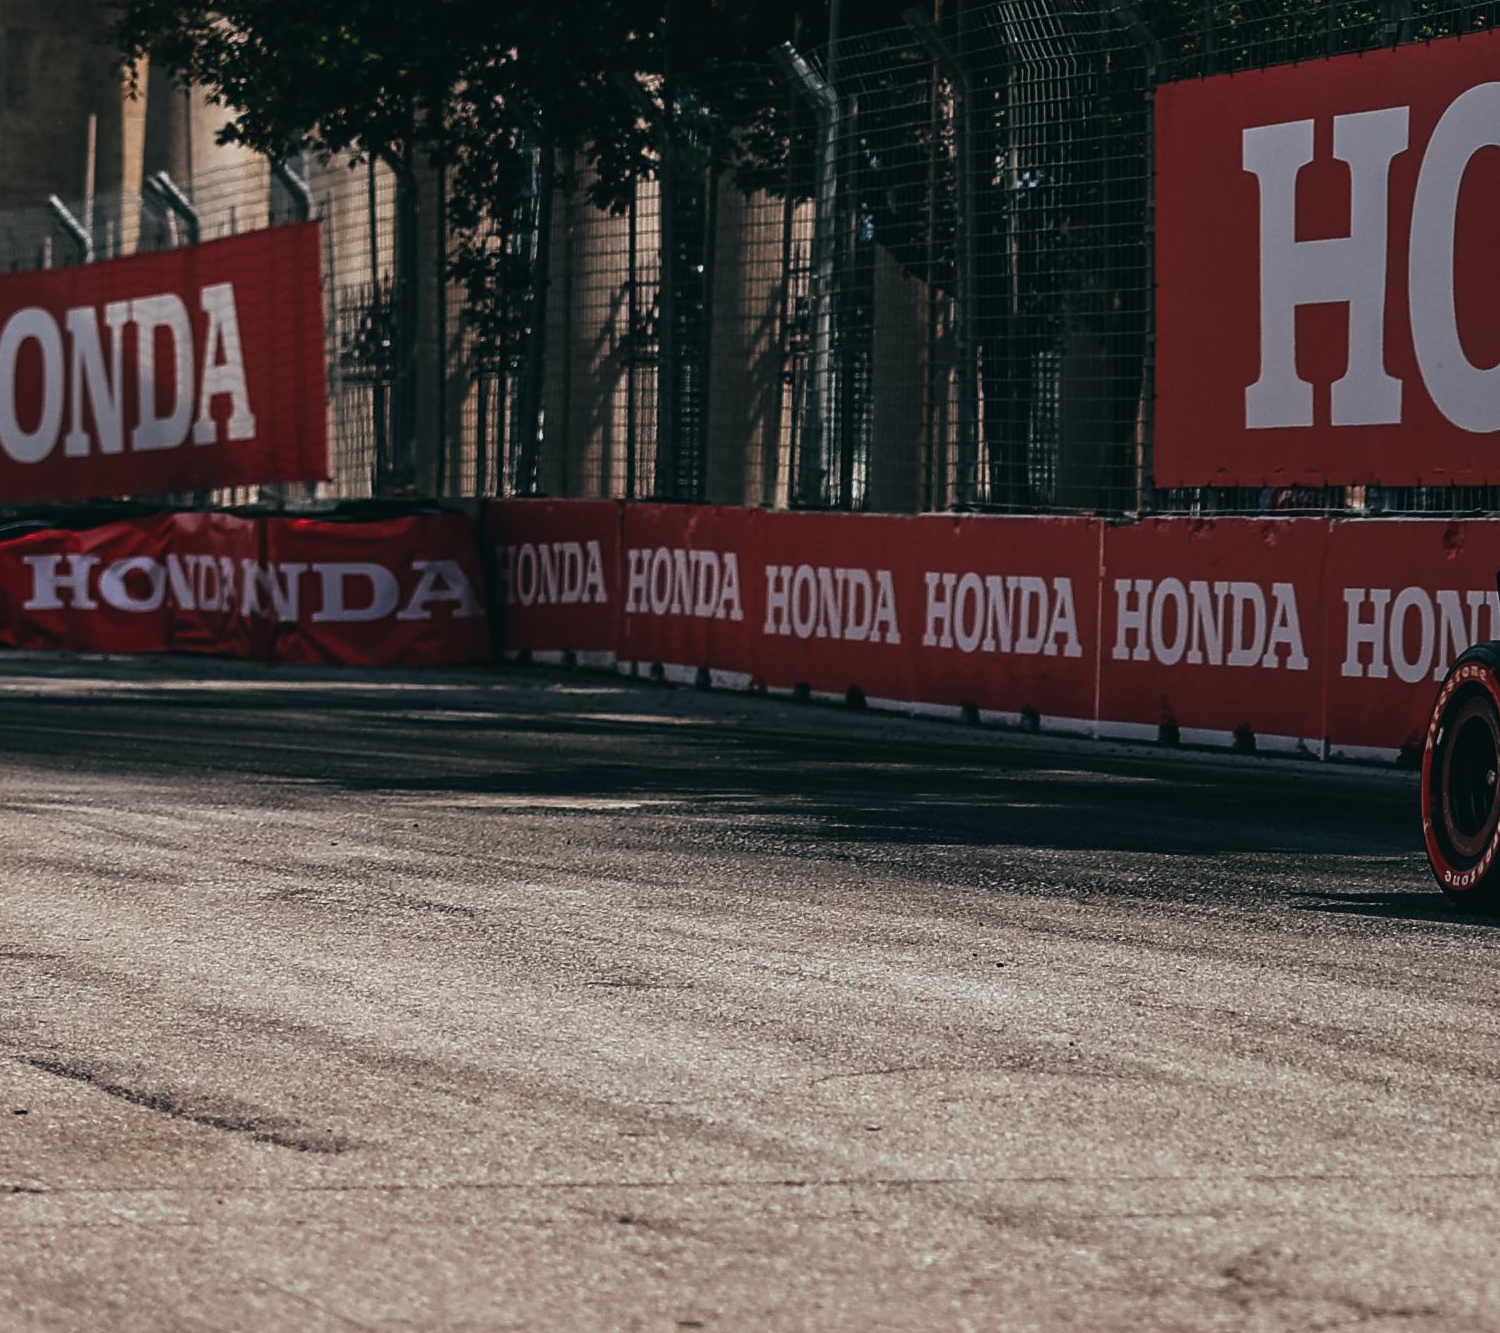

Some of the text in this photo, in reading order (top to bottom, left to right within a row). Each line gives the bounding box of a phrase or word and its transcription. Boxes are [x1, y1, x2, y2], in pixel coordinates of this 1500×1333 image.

[496, 540, 608, 605] HONDA
[625, 546, 743, 620] HONDA
[762, 564, 901, 644] HONDA
[922, 572, 1082, 658] HONDA
[1112, 577, 1309, 670] HONDA
